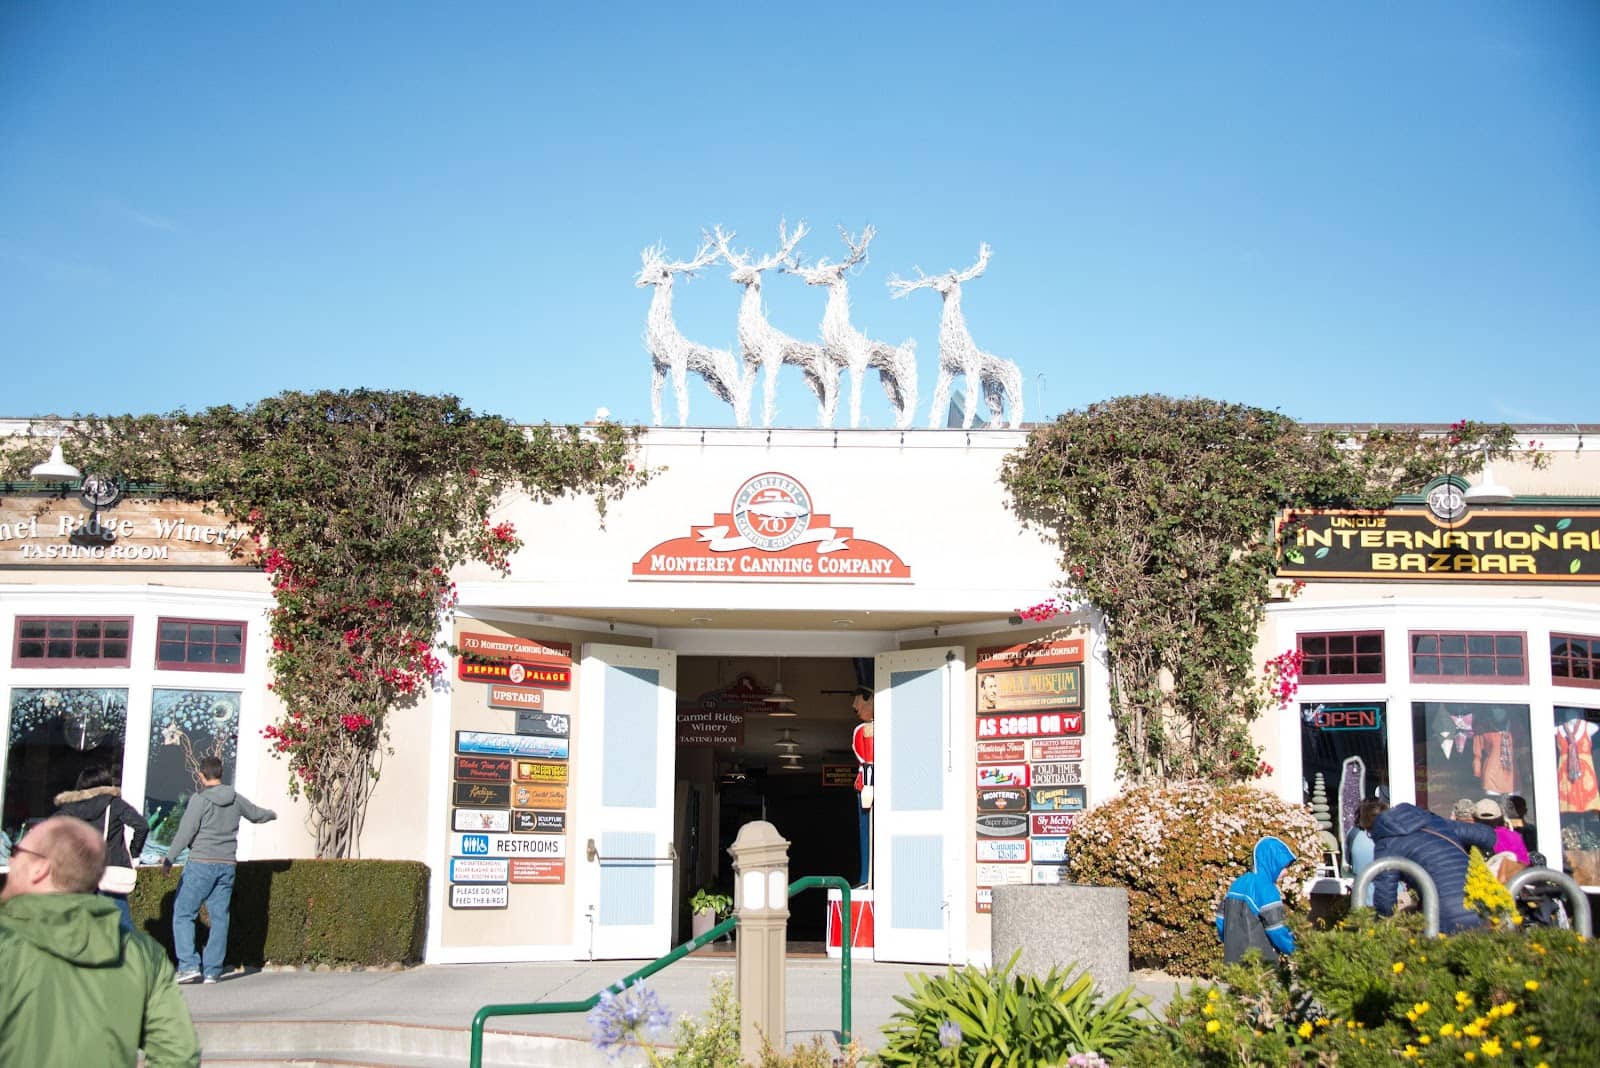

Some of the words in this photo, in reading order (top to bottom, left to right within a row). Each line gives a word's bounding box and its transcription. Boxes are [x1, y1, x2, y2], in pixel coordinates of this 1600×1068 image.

[746, 478, 801, 495] MONTEREY
[1432, 493, 1462, 510] 700
[59, 514, 134, 542] Ridge
[757, 516, 787, 533] 700
[1330, 516, 1387, 528] UNIQUE
[20, 544, 105, 559] TASTING
[111, 545, 168, 560] ROOM
[650, 553, 736, 573] MONTEREY
[740, 555, 813, 574] CANNING
[818, 556, 893, 575] COMPANY
[1371, 552, 1537, 574] BAZAAR
[480, 640, 513, 652] MONTEREY
[513, 643, 542, 656] CANNING
[542, 646, 570, 657] COMPANY
[1050, 646, 1080, 656] COMPANY
[466, 665, 508, 676] PEPPER
[526, 671, 566, 682] PALACE
[1030, 672, 1075, 692] MUSEUM
[493, 690, 541, 704] UPSTAIRS
[677, 712, 712, 723] Carmel
[715, 712, 743, 724] Ridge
[1064, 718, 1079, 729] TV
[1314, 711, 1375, 728] OPEN
[692, 723, 728, 733] Winery
[1038, 764, 1054, 774] OLD
[1057, 764, 1075, 774] TIME
[1035, 774, 1078, 784] PORTRAITS
[983, 791, 1020, 801] MONTEREY
[1050, 815, 1075, 827] McFly
[496, 840, 559, 853] RESTROOMS
[990, 841, 1025, 850] Cinnamon
[456, 887, 479, 895] PLEASE
[455, 897, 471, 905] FEED
[486, 897, 505, 905] BIRDS
